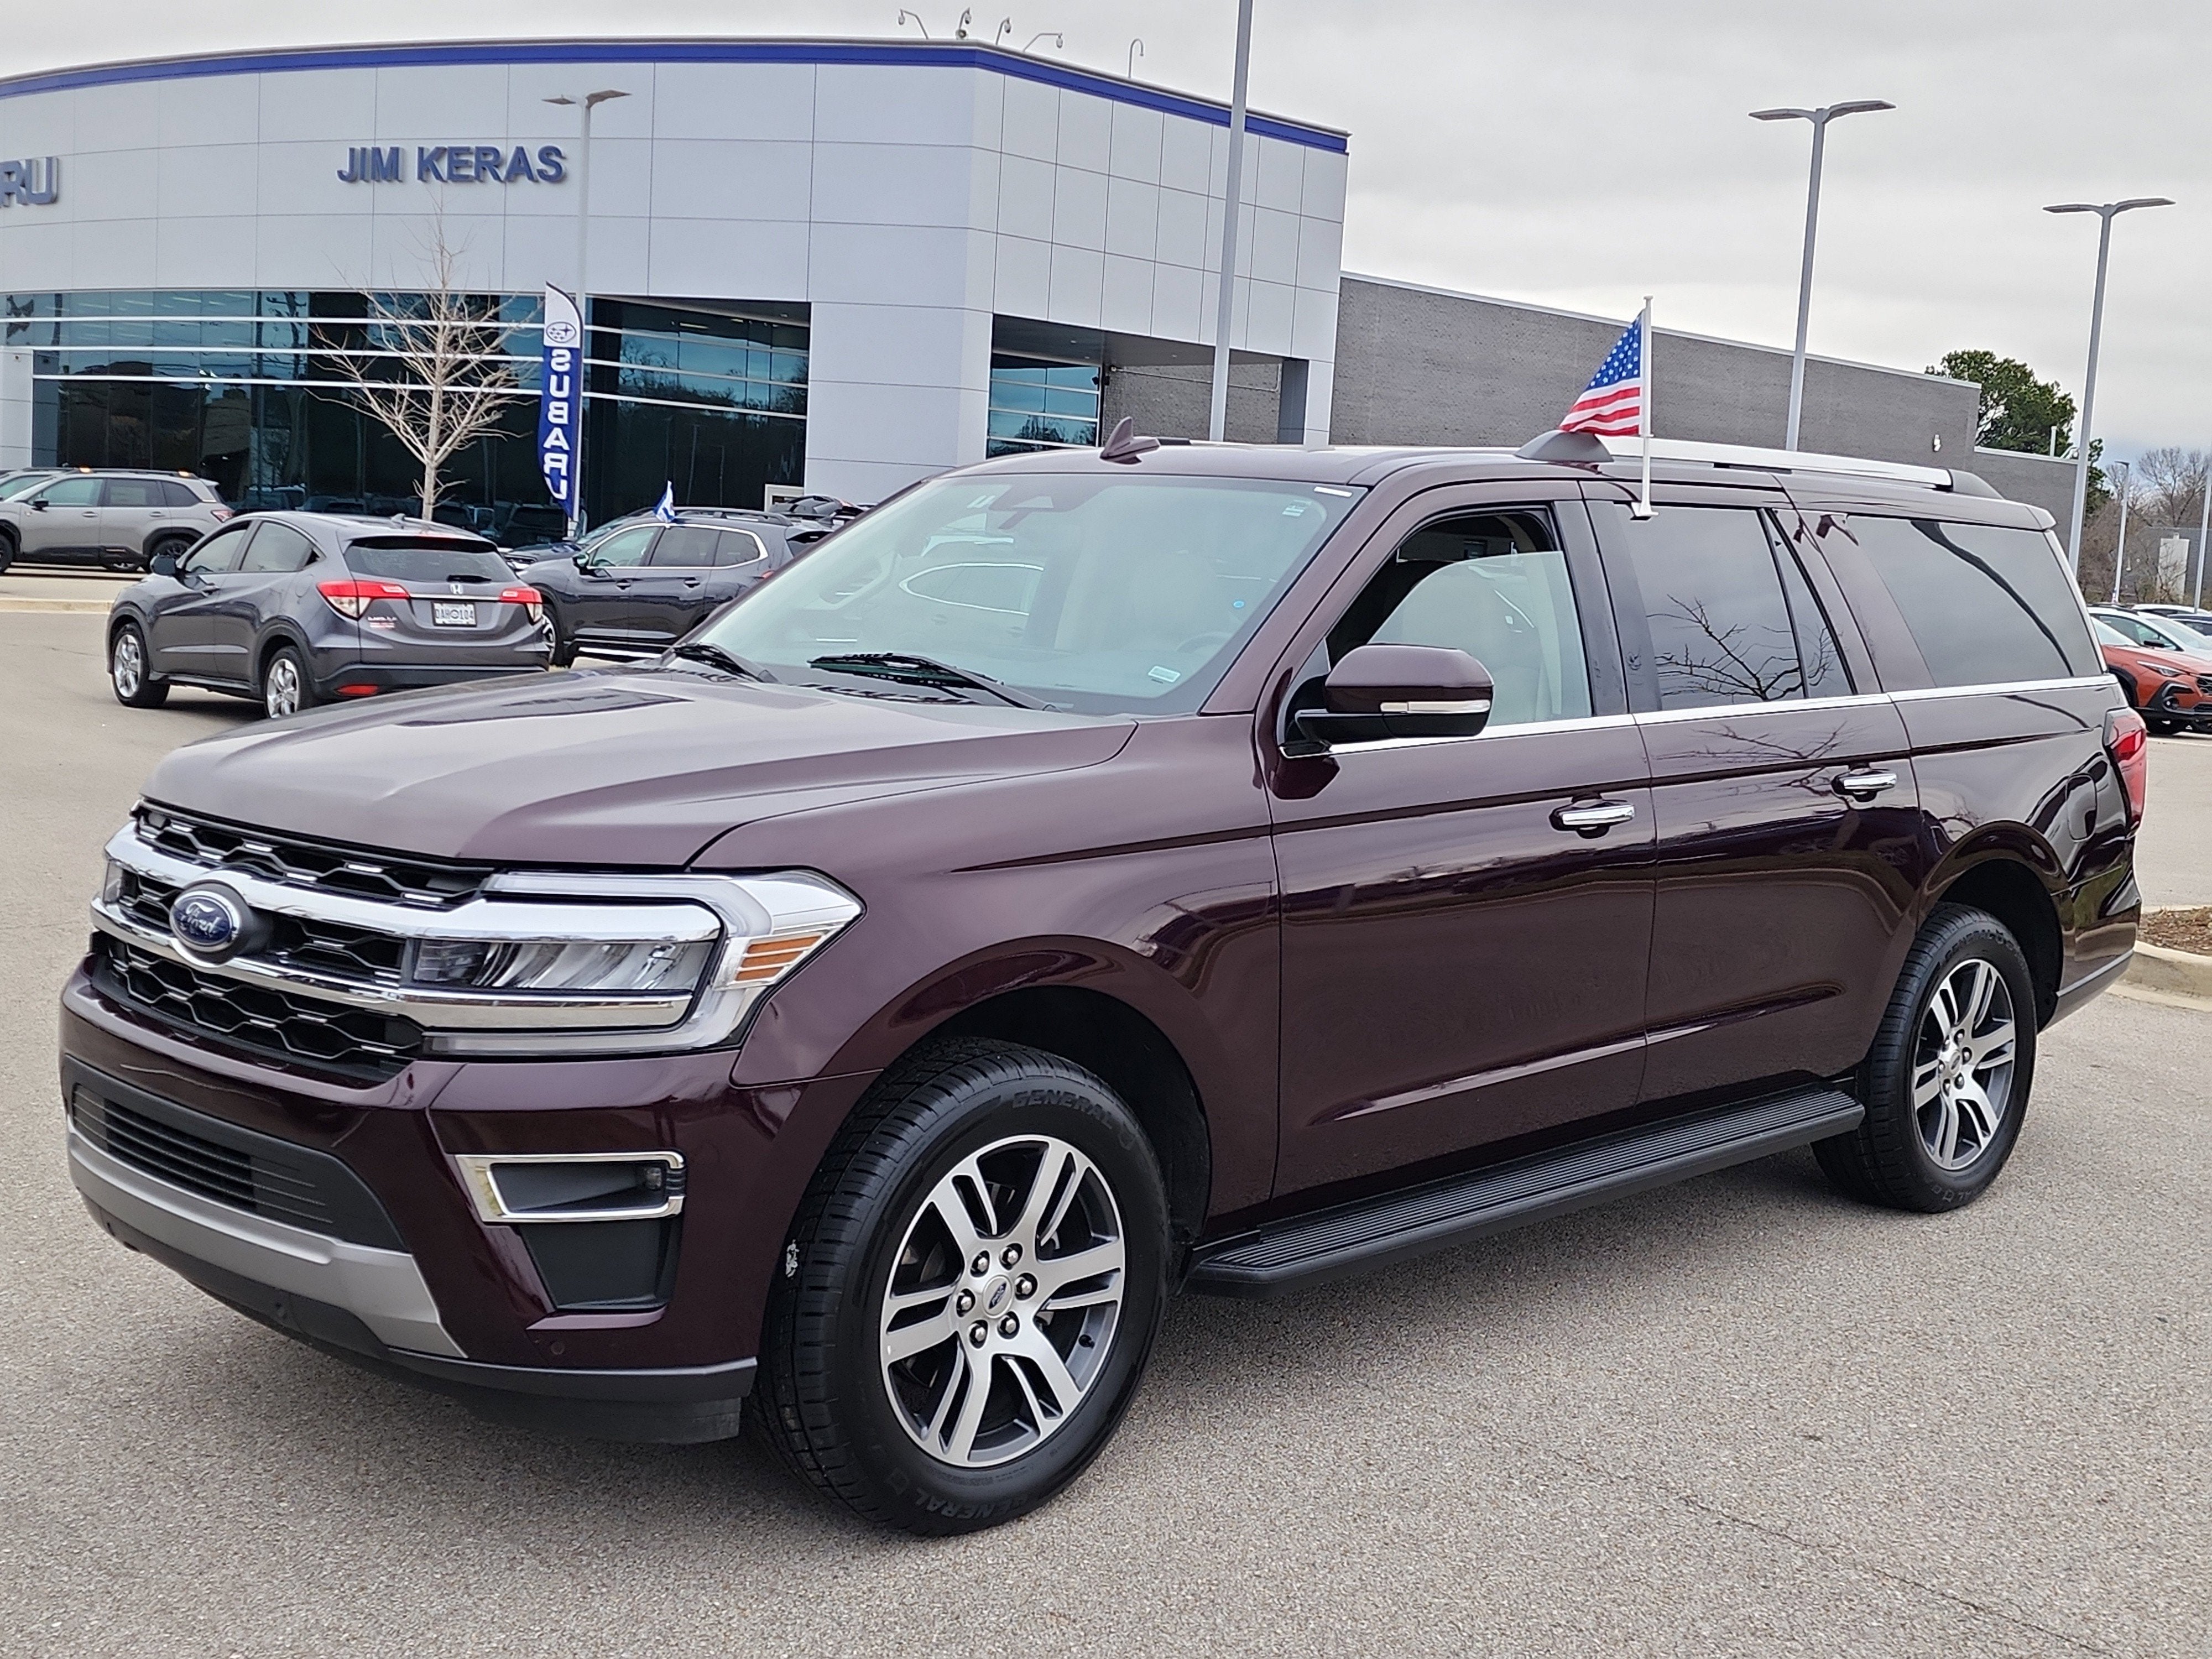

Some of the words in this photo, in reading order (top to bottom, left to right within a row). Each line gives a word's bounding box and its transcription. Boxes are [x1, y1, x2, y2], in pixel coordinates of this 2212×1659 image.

[337, 147, 401, 182] JIM
[417, 145, 566, 183] KERAS
[1012, 1089, 1113, 1130] GENERAL
